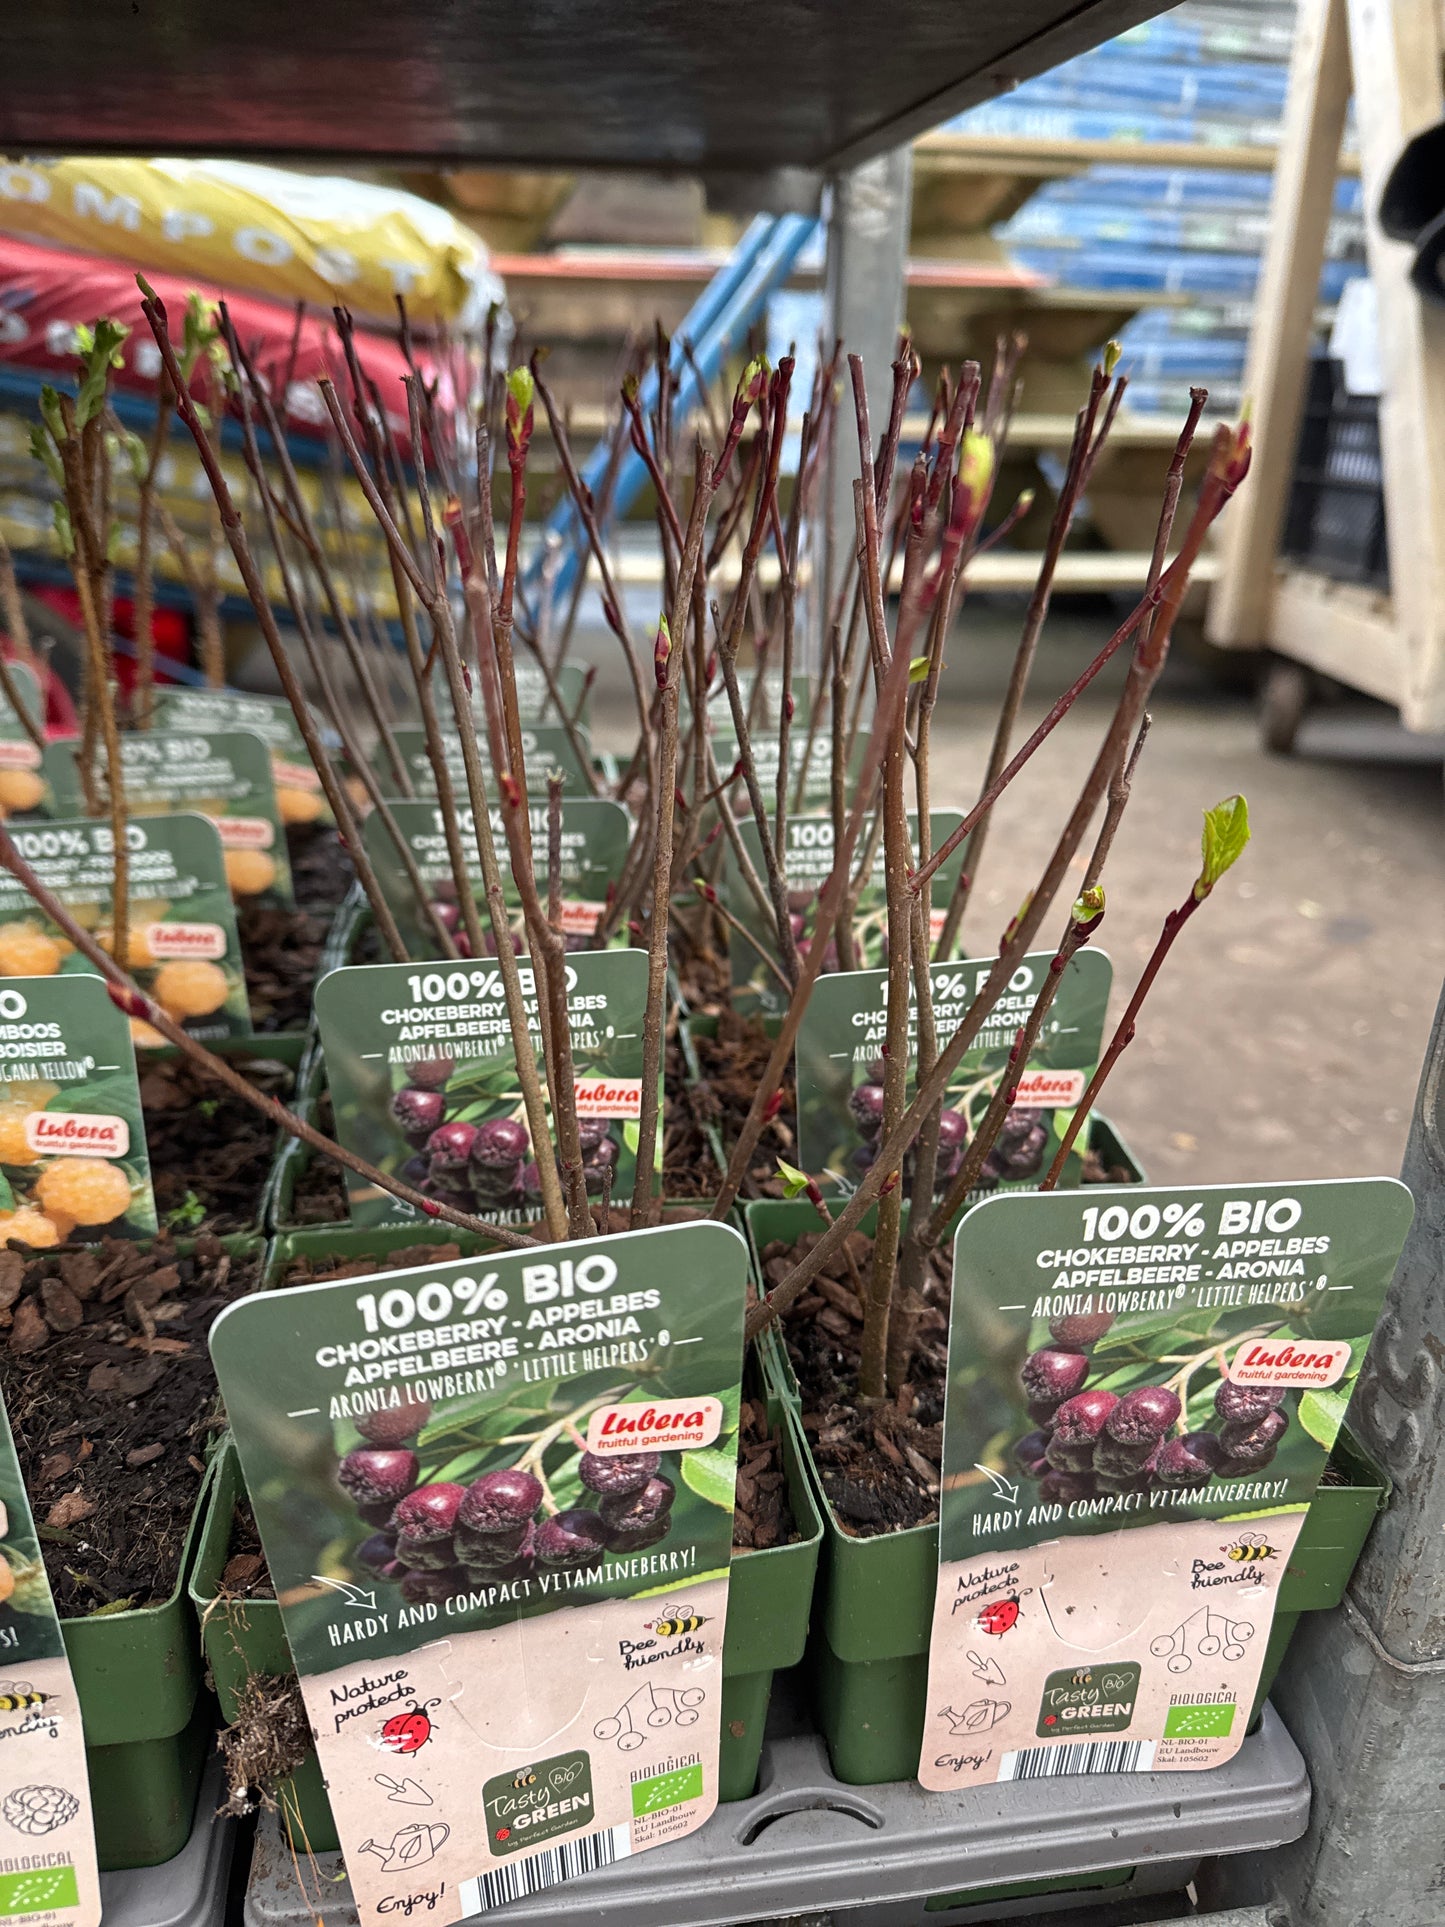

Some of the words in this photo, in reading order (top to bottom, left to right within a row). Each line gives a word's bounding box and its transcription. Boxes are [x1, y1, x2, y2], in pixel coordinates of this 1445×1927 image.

[92, 825, 147, 852] BO
[407, 970, 505, 1003] 100%
[381, 1002, 506, 1025] CHOKEBERRY
[398, 1018, 512, 1041] APFELBEERE
[387, 1043, 436, 1064] ARONIA
[1018, 1075, 1073, 1092] ubera
[1082, 1202, 1206, 1242] 100%
[1217, 1198, 1302, 1236] BIO
[1036, 1243, 1200, 1268] CHOKEBERRY
[1212, 1235, 1331, 1260] APPELBES
[1051, 1264, 1202, 1289] APFELBEERE
[1215, 1259, 1305, 1280] ARONIA
[356, 1272, 509, 1333] 100%
[522, 1254, 618, 1304] BIO
[1031, 1293, 1093, 1318] ARONIA
[315, 1315, 508, 1367] CHOKEBERRY
[526, 1289, 661, 1330] APPELBES
[344, 1337, 519, 1387] APFELBEERE
[538, 1316, 641, 1351] ARONIA
[1237, 1370, 1271, 1380] fruitful
[1274, 1371, 1328, 1382] gardening
[329, 1385, 400, 1420] ARONIA
[598, 1437, 638, 1449] fruitful
[642, 1431, 704, 1446] gardening
[972, 1508, 1022, 1536] HARDY
[1027, 1503, 1063, 1525] AND
[1067, 1492, 1144, 1520] COMPACT
[1149, 1478, 1290, 1509] VITAMINEBERRY!
[957, 1561, 1020, 1592] Nature
[1191, 1558, 1225, 1574] Bee
[1191, 1567, 1265, 1590] friendly
[327, 1614, 389, 1647] HARDY
[398, 1604, 438, 1630] AND
[445, 1578, 531, 1617] COMPACT
[538, 1545, 697, 1595] VITAMINEBERRY!
[951, 1576, 1019, 1615] protects
[619, 1637, 657, 1656] Bee
[623, 1638, 706, 1671] friendly
[330, 1668, 409, 1705] Nature
[1105, 1678, 1125, 1690] BIO
[334, 1683, 416, 1733] protects
[1044, 1687, 1099, 1707] Tasty
[1169, 1691, 1237, 1706] BIOLOGICAL
[1061, 1702, 1132, 1720] GREEN
[1161, 1738, 1208, 1746] NL-BIO-01
[1174, 1746, 1220, 1755] Landbouw
[630, 1752, 702, 1782] BIOLOGICAL
[935, 1749, 992, 1772] Enjoy!
[1157, 1755, 1177, 1763] Skal:
[1178, 1755, 1209, 1763] 105602
[553, 1771, 575, 1784] BIO
[486, 1786, 550, 1817] Tasty
[512, 1792, 590, 1830] GREEN
[633, 1804, 683, 1825] NL-BIO-01
[634, 1824, 649, 1835] EU
[650, 1810, 697, 1831] Landbouw
[634, 1832, 656, 1845] Skal:
[657, 1820, 688, 1837] 105602
[377, 1882, 445, 1916] Enjoy!
